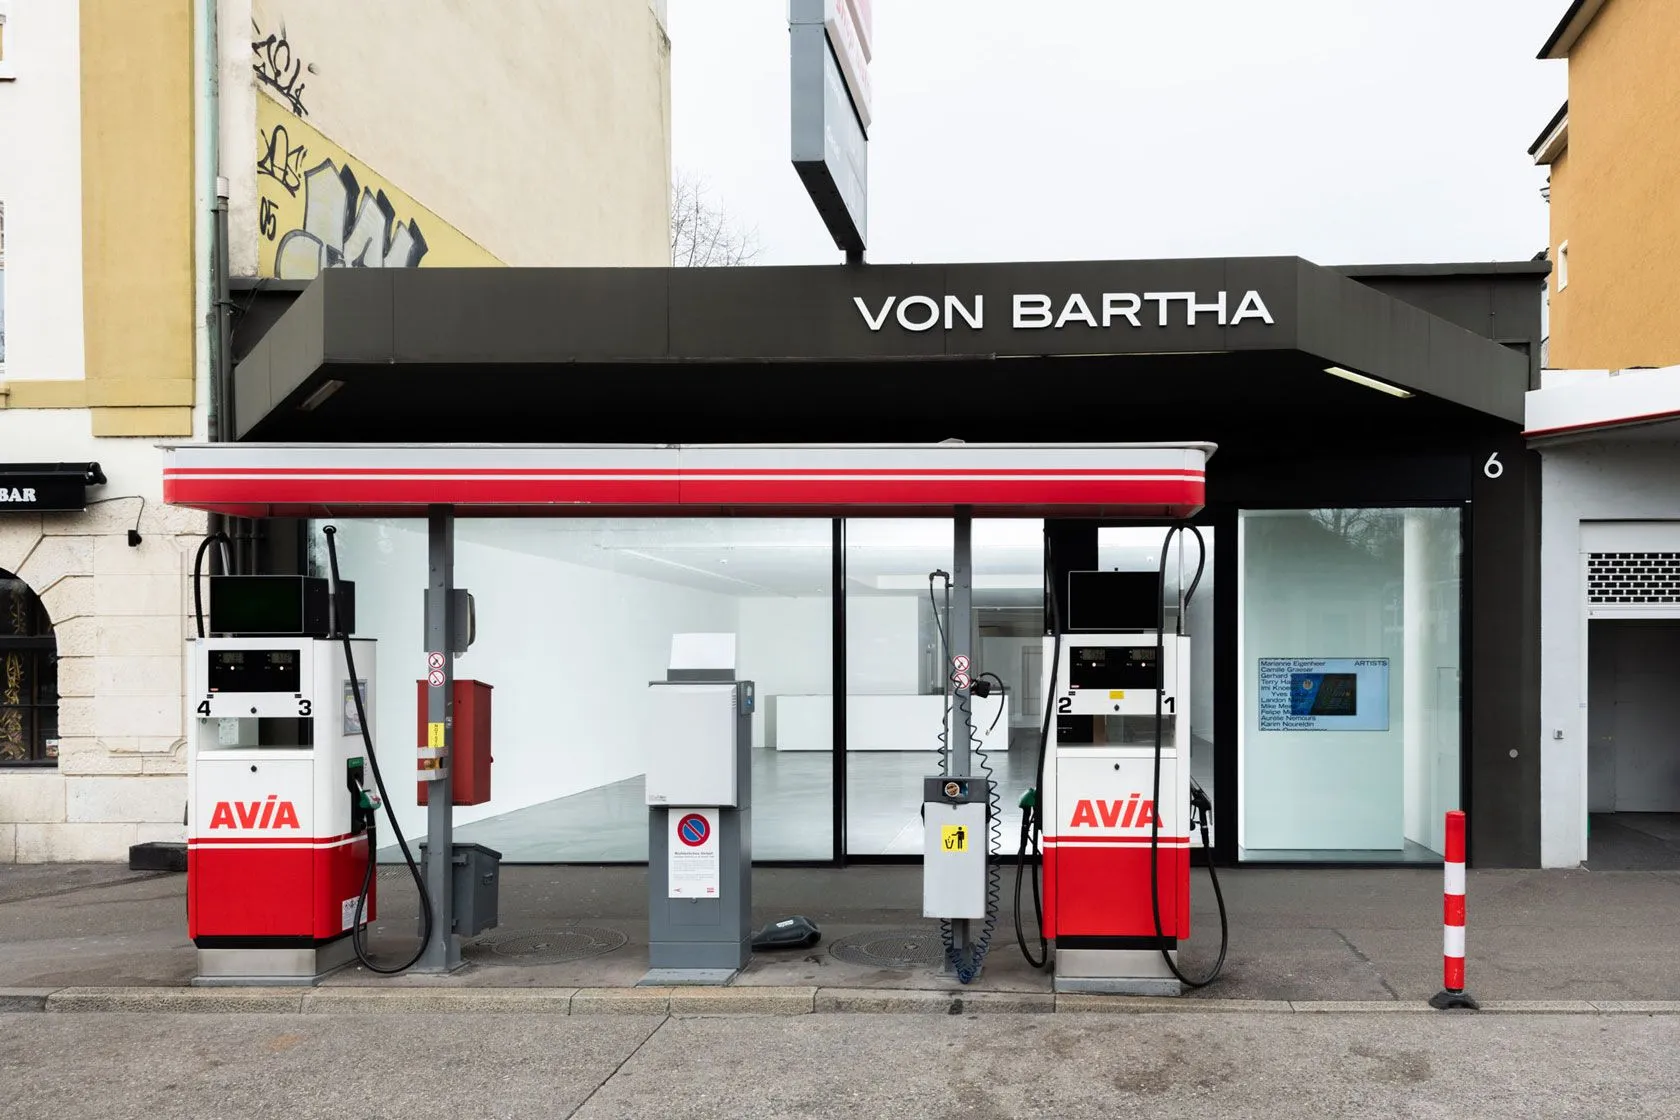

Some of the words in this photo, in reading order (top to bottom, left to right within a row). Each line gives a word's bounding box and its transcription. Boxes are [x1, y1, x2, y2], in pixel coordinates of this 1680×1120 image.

[853, 294, 984, 331] VON
[1012, 290, 1274, 328] BARTHA
[1483, 452, 1504, 479] 6
[0, 487, 37, 502] BAR
[197, 700, 211, 716] 4
[298, 700, 312, 716] 3
[1058, 697, 1072, 713] 2
[1164, 697, 1175, 713] 1
